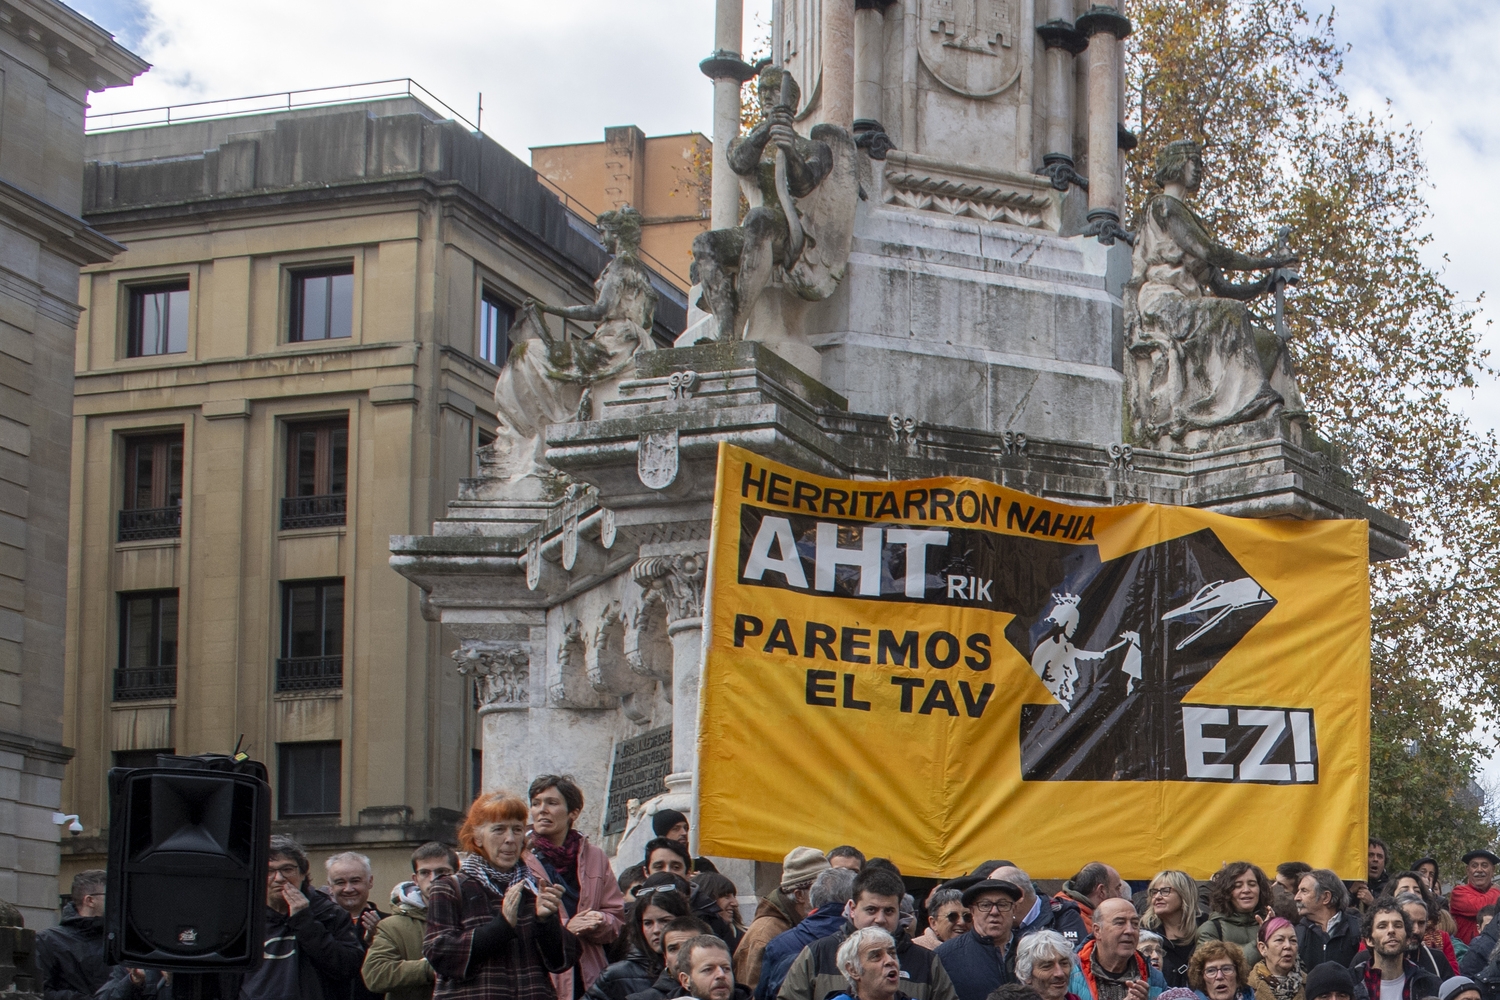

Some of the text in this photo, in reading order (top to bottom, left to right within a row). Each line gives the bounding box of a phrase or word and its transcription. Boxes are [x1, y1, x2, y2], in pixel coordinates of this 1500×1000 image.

[741, 462, 1096, 541] HERRITARRON NAHIA
[743, 515, 993, 602] AHT RIK
[733, 613, 992, 672] PAREMOS
[805, 668, 996, 718] EL TAV
[1182, 706, 1315, 782] EZ!
